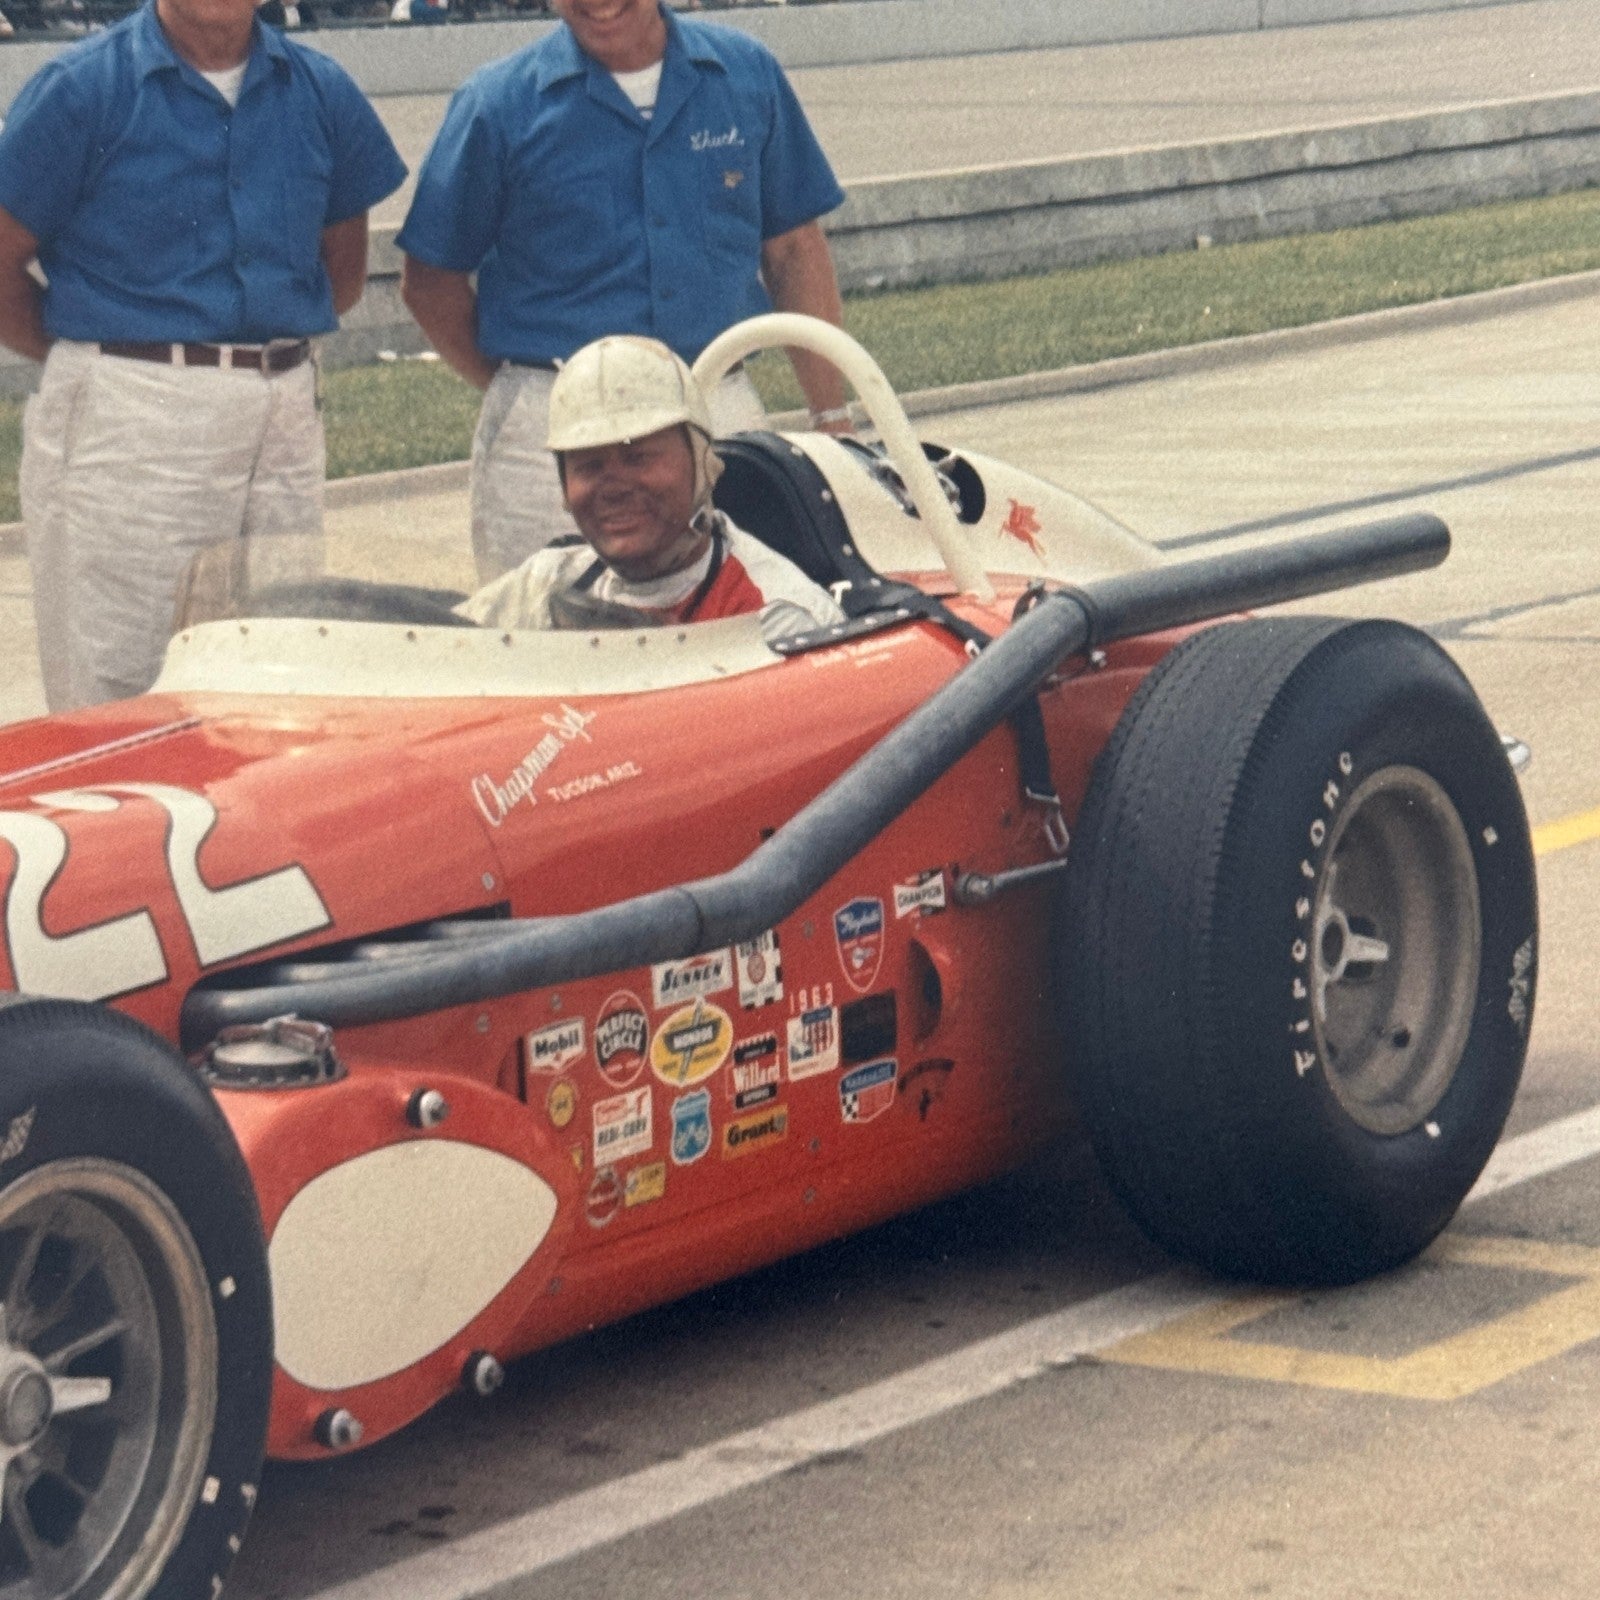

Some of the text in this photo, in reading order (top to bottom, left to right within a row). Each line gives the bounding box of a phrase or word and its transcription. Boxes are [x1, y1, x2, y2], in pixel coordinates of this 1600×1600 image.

[471, 732, 566, 828] Chapman
[0, 780, 335, 1003] 22
[788, 982, 834, 1016] 1963
[534, 1028, 580, 1059] Mobil
[733, 1050, 781, 1095] Willard
[727, 1117, 777, 1147] Grant
